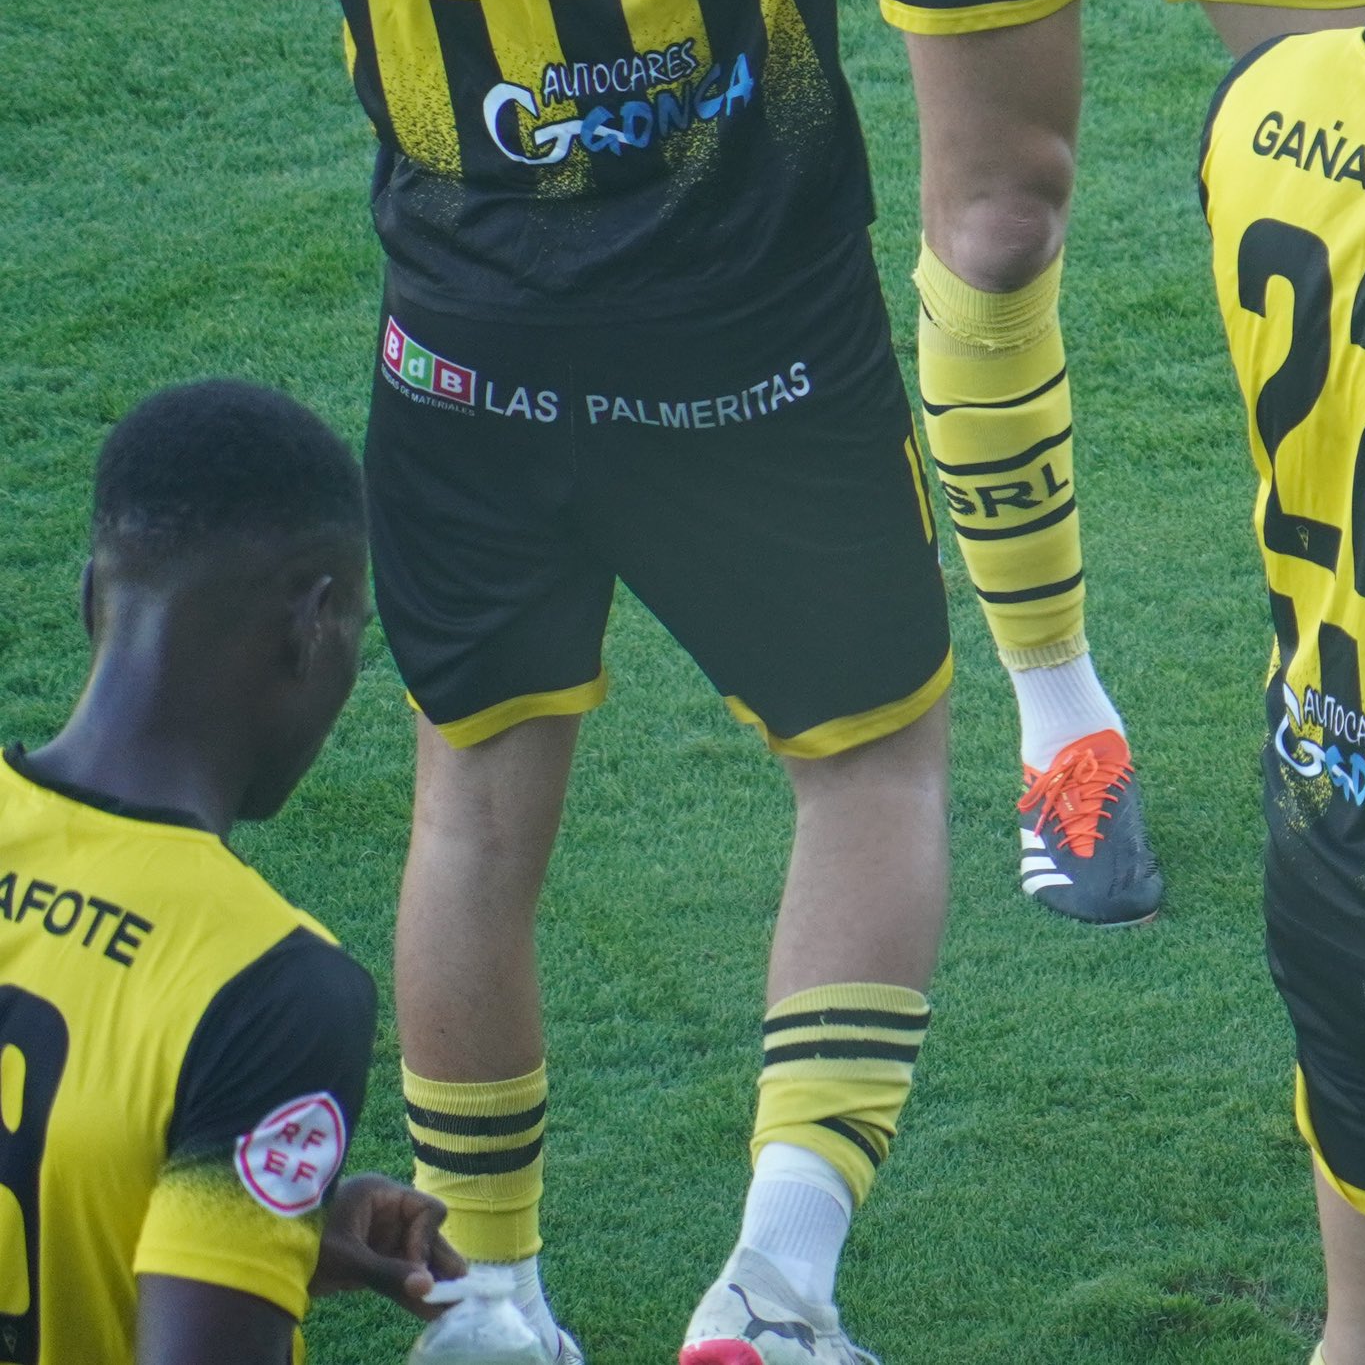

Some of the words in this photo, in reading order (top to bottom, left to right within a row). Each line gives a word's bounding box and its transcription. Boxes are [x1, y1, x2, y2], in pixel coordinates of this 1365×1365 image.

[543, 41, 697, 104] AUTOCARES
[485, 381, 559, 423] LAS
[585, 361, 812, 429] PALMERITAS
[942, 463, 1070, 518] SRL
